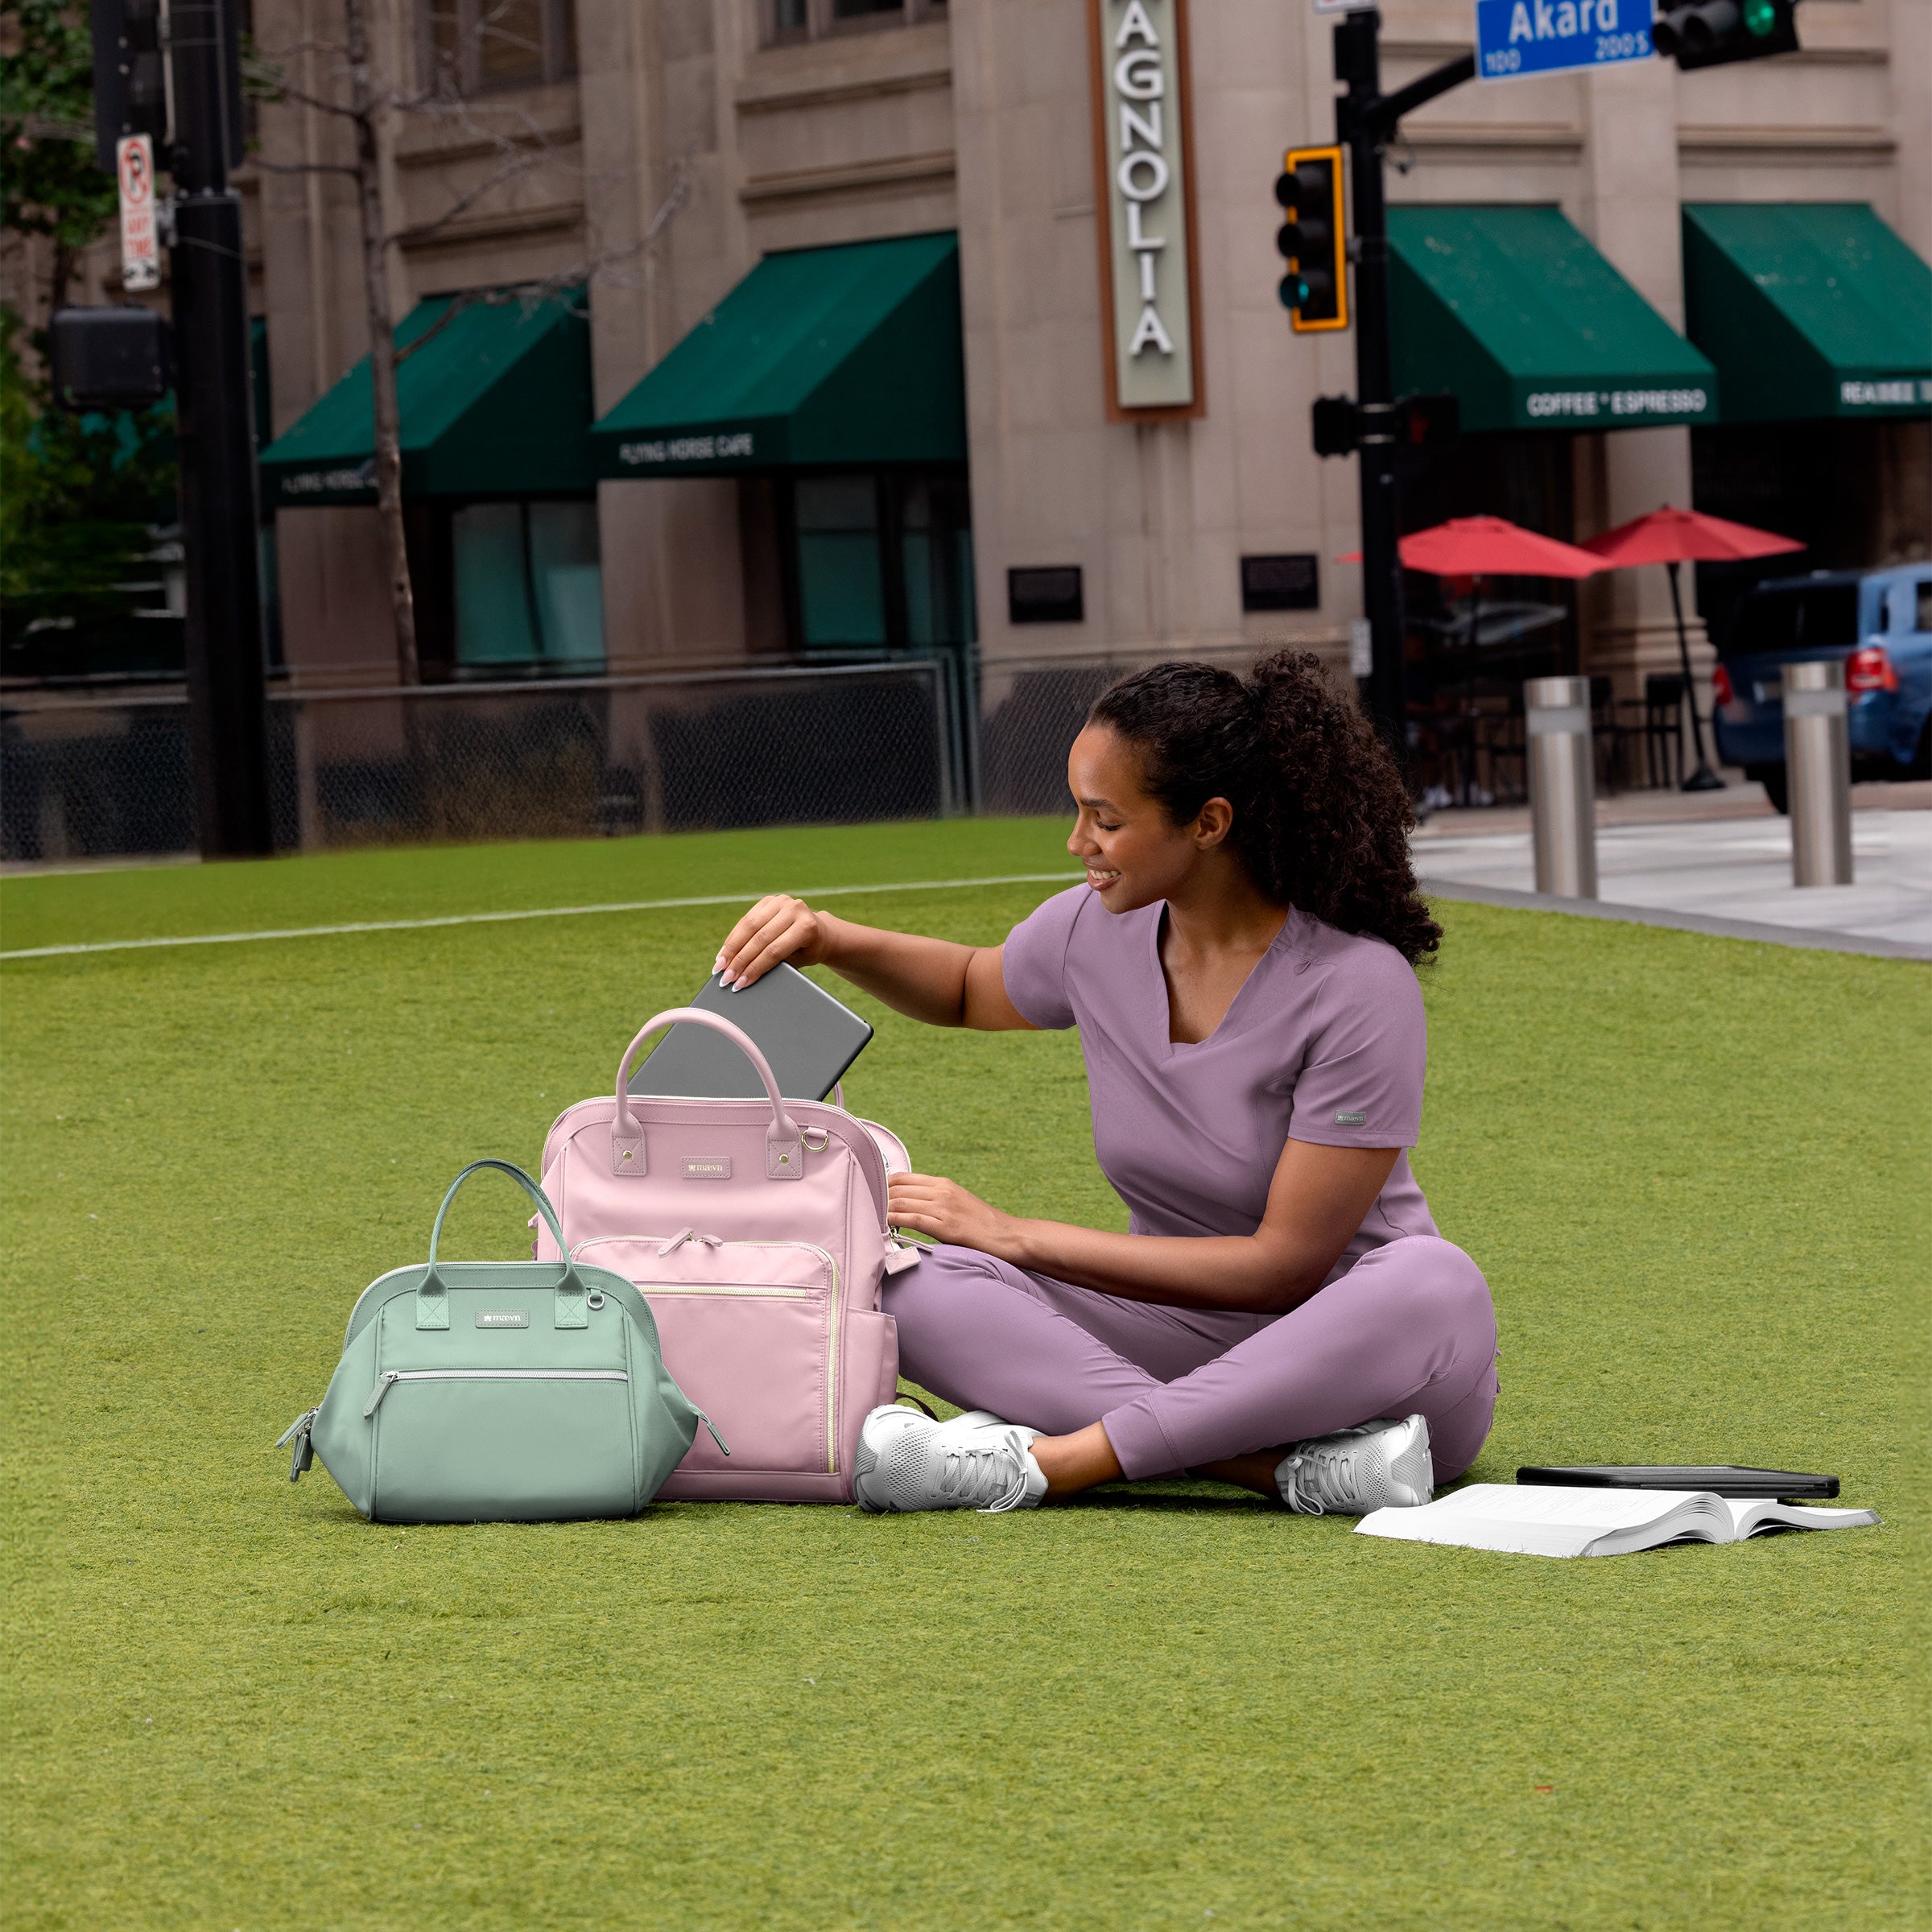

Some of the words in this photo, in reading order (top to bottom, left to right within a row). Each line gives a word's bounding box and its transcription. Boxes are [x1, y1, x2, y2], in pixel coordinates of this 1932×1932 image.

[1509, 0, 1618, 43] Akard
[1485, 48, 1521, 72] 100
[1526, 392, 1599, 417] COFFEE
[1611, 388, 1707, 414] ESPRESSO
[667, 436, 715, 460] HORSE
